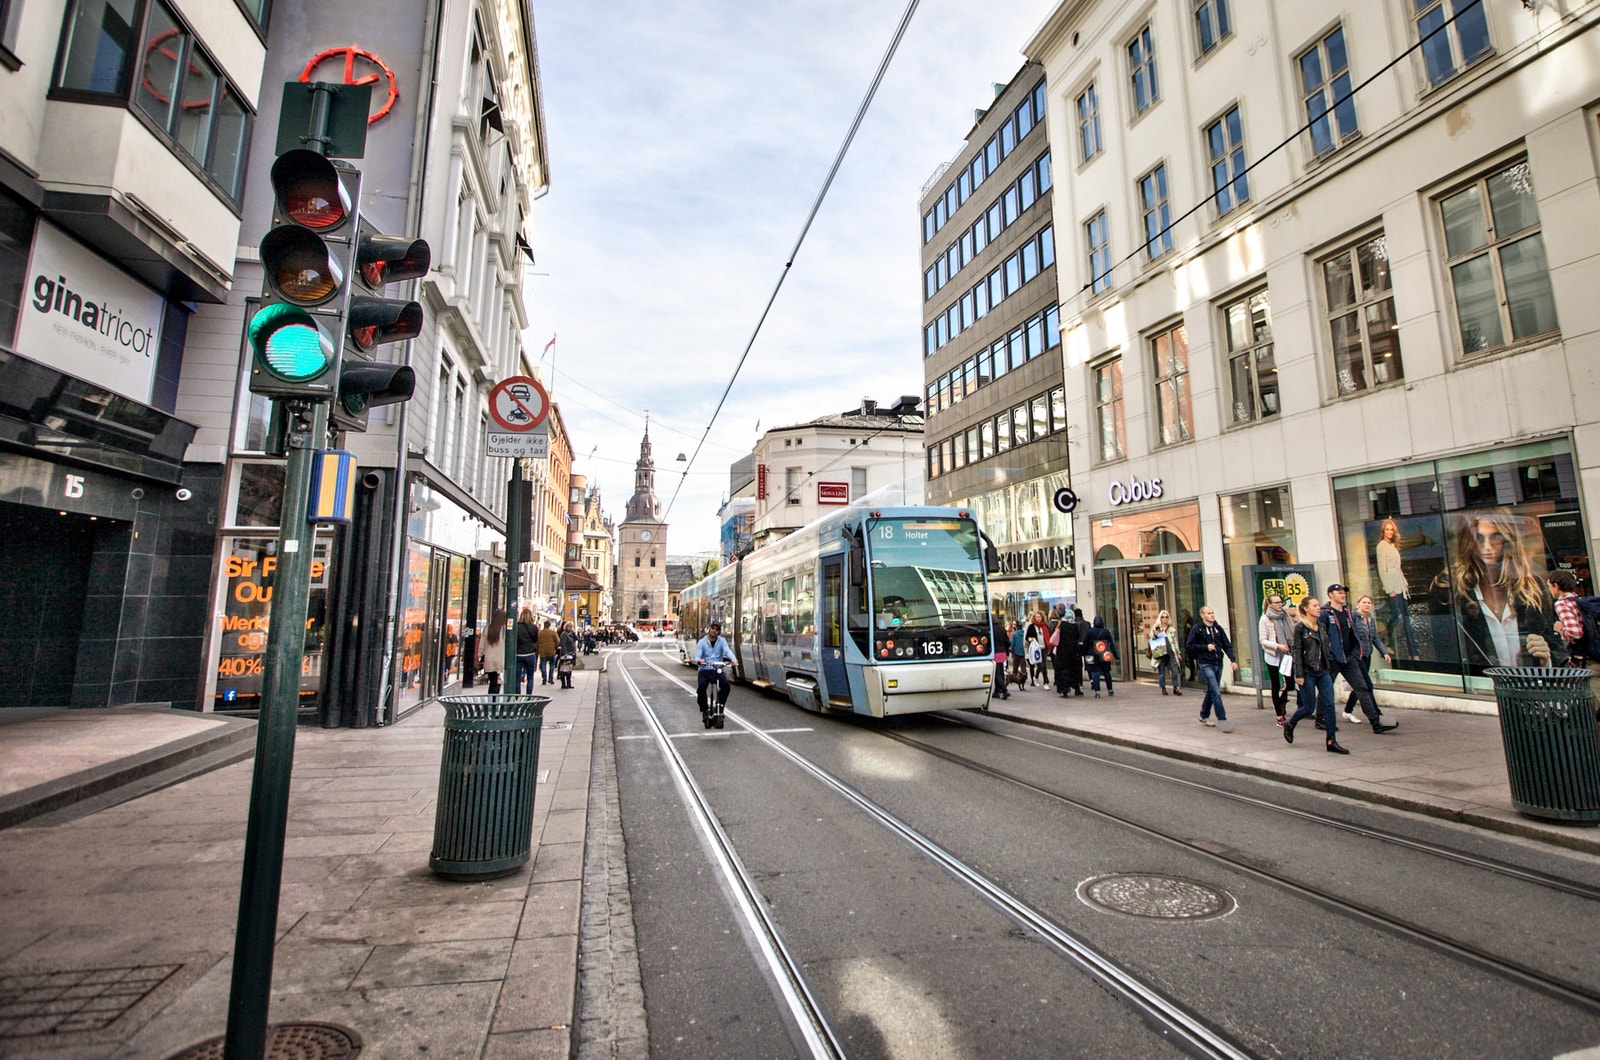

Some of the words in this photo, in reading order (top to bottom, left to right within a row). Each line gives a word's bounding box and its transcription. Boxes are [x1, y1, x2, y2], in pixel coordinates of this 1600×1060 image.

[33, 274, 152, 357] ginatricot
[491, 435, 521, 445] Gjelder
[526, 436, 544, 444] ikke
[488, 446, 509, 454] buss
[514, 448, 525, 456] og
[65, 474, 85, 498] 15
[1109, 475, 1162, 505] Cubus
[1058, 491, 1074, 509] C
[879, 526, 893, 539] 18
[905, 531, 928, 539] Holtet
[224, 555, 257, 577] Sir
[1264, 581, 1284, 589] SUB
[1288, 583, 1301, 595] 35
[922, 641, 943, 655] 163
